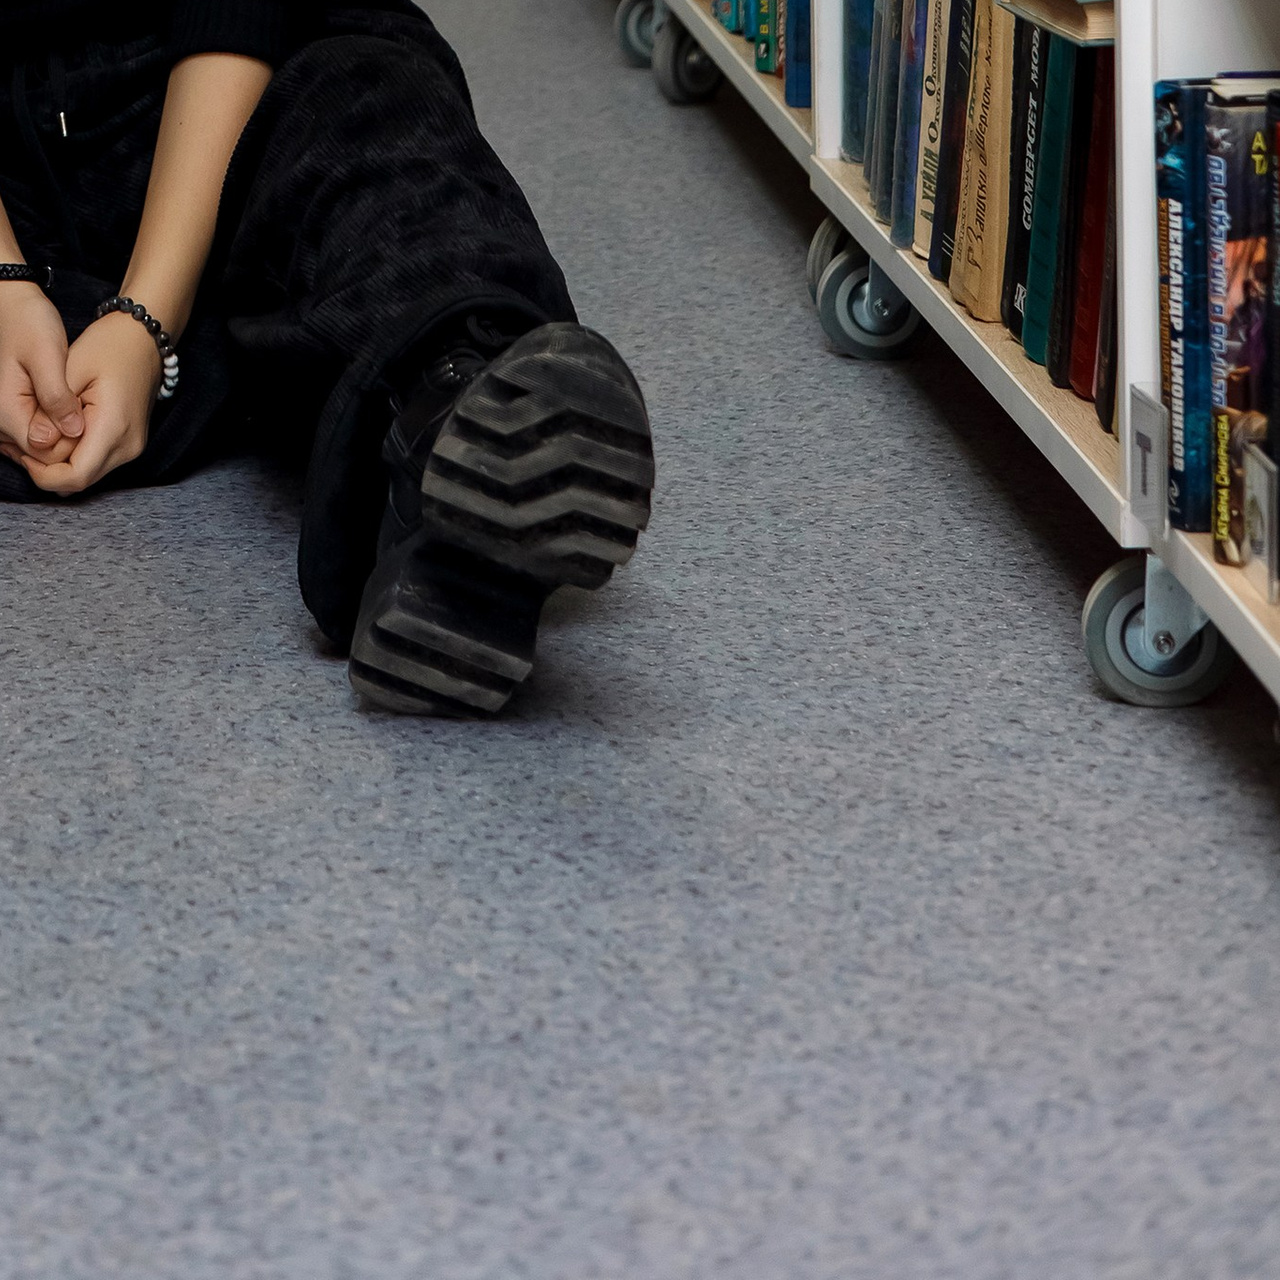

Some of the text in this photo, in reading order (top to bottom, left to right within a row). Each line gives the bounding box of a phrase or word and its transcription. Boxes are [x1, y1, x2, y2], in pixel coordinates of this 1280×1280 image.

[921, 145, 940, 206] ХЕЙЛИ
[1022, 25, 1041, 231] СОМЕРСЕТ МОЭ
[1158, 197, 1170, 276] ЖЕНЩИНА
[1168, 197, 1185, 472] АЛЕКСАНДР ТАМОНИКОВ
